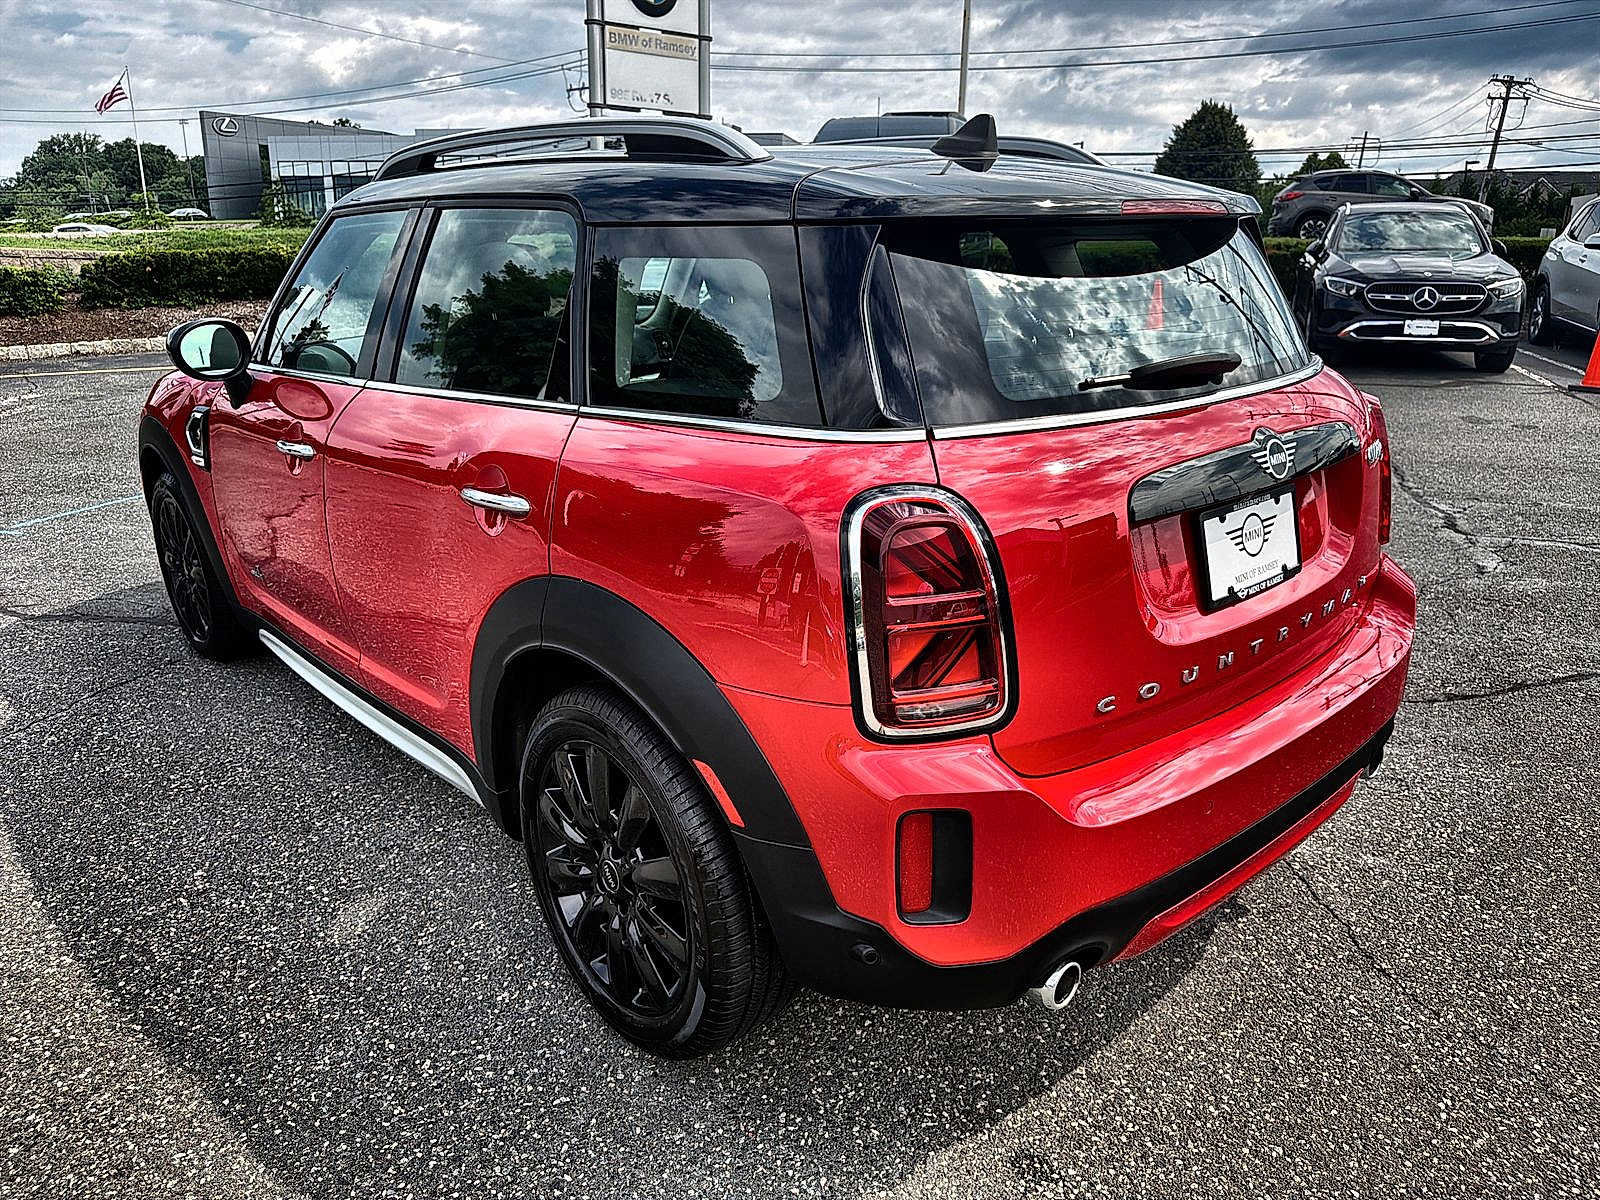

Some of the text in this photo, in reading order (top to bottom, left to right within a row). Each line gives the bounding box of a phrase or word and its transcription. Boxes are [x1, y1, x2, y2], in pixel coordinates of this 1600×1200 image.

[609, 31, 697, 57] BMW of Ramsey
[1269, 453, 1287, 466] MINI
[1244, 527, 1262, 543] MINI
[1235, 571, 1249, 585] MINI
[1257, 559, 1279, 576] RAMSEY
[604, 864, 616, 888] MINI
